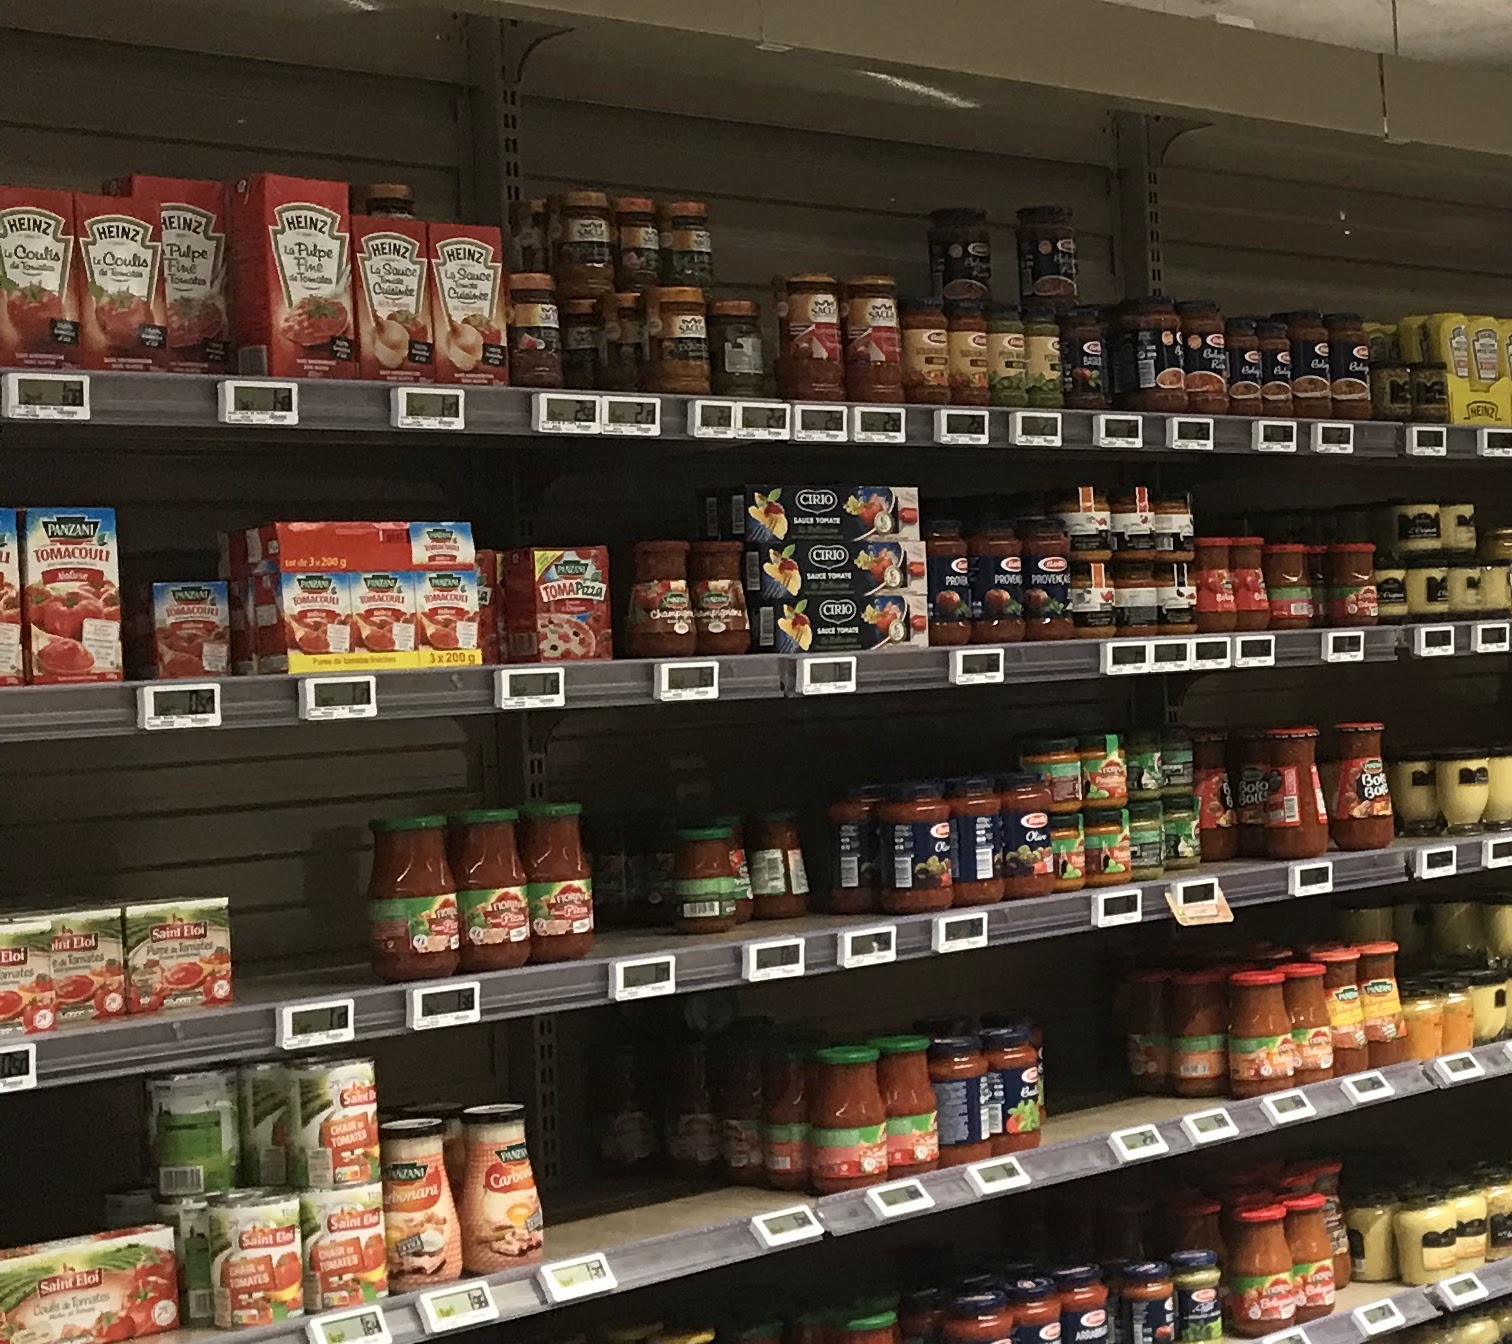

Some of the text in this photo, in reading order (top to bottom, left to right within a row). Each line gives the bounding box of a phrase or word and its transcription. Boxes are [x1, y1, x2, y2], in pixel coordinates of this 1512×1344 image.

[7, 217, 52, 236] HEINZ
[286, 215, 328, 234] HEINZ
[97, 226, 141, 243] HEINZ
[14, 244, 61, 262] Coulis
[295, 242, 333, 259] Pulpe
[371, 242, 409, 258] HEINZ
[446, 248, 484, 264] HEINZ
[103, 251, 148, 268] Coulis
[799, 494, 835, 506] CIRIO
[47, 523, 94, 538] PANZANI
[33, 546, 110, 563] TOMACOULI
[812, 549, 845, 560] CIRIO
[650, 609, 694, 620] Champign
[822, 605, 852, 615] CIRIO
[152, 925, 205, 940] Saint Eloi
[72, 936, 96, 950] Eloi
[331, 1129, 367, 1147] TOMATES
[330, 1215, 361, 1231] Saint
[241, 1229, 294, 1247] Saint Eloi
[320, 1254, 358, 1271] TOMATES
[40, 1272, 100, 1295] Saint Eloi
[229, 1272, 269, 1288] TOMATES
